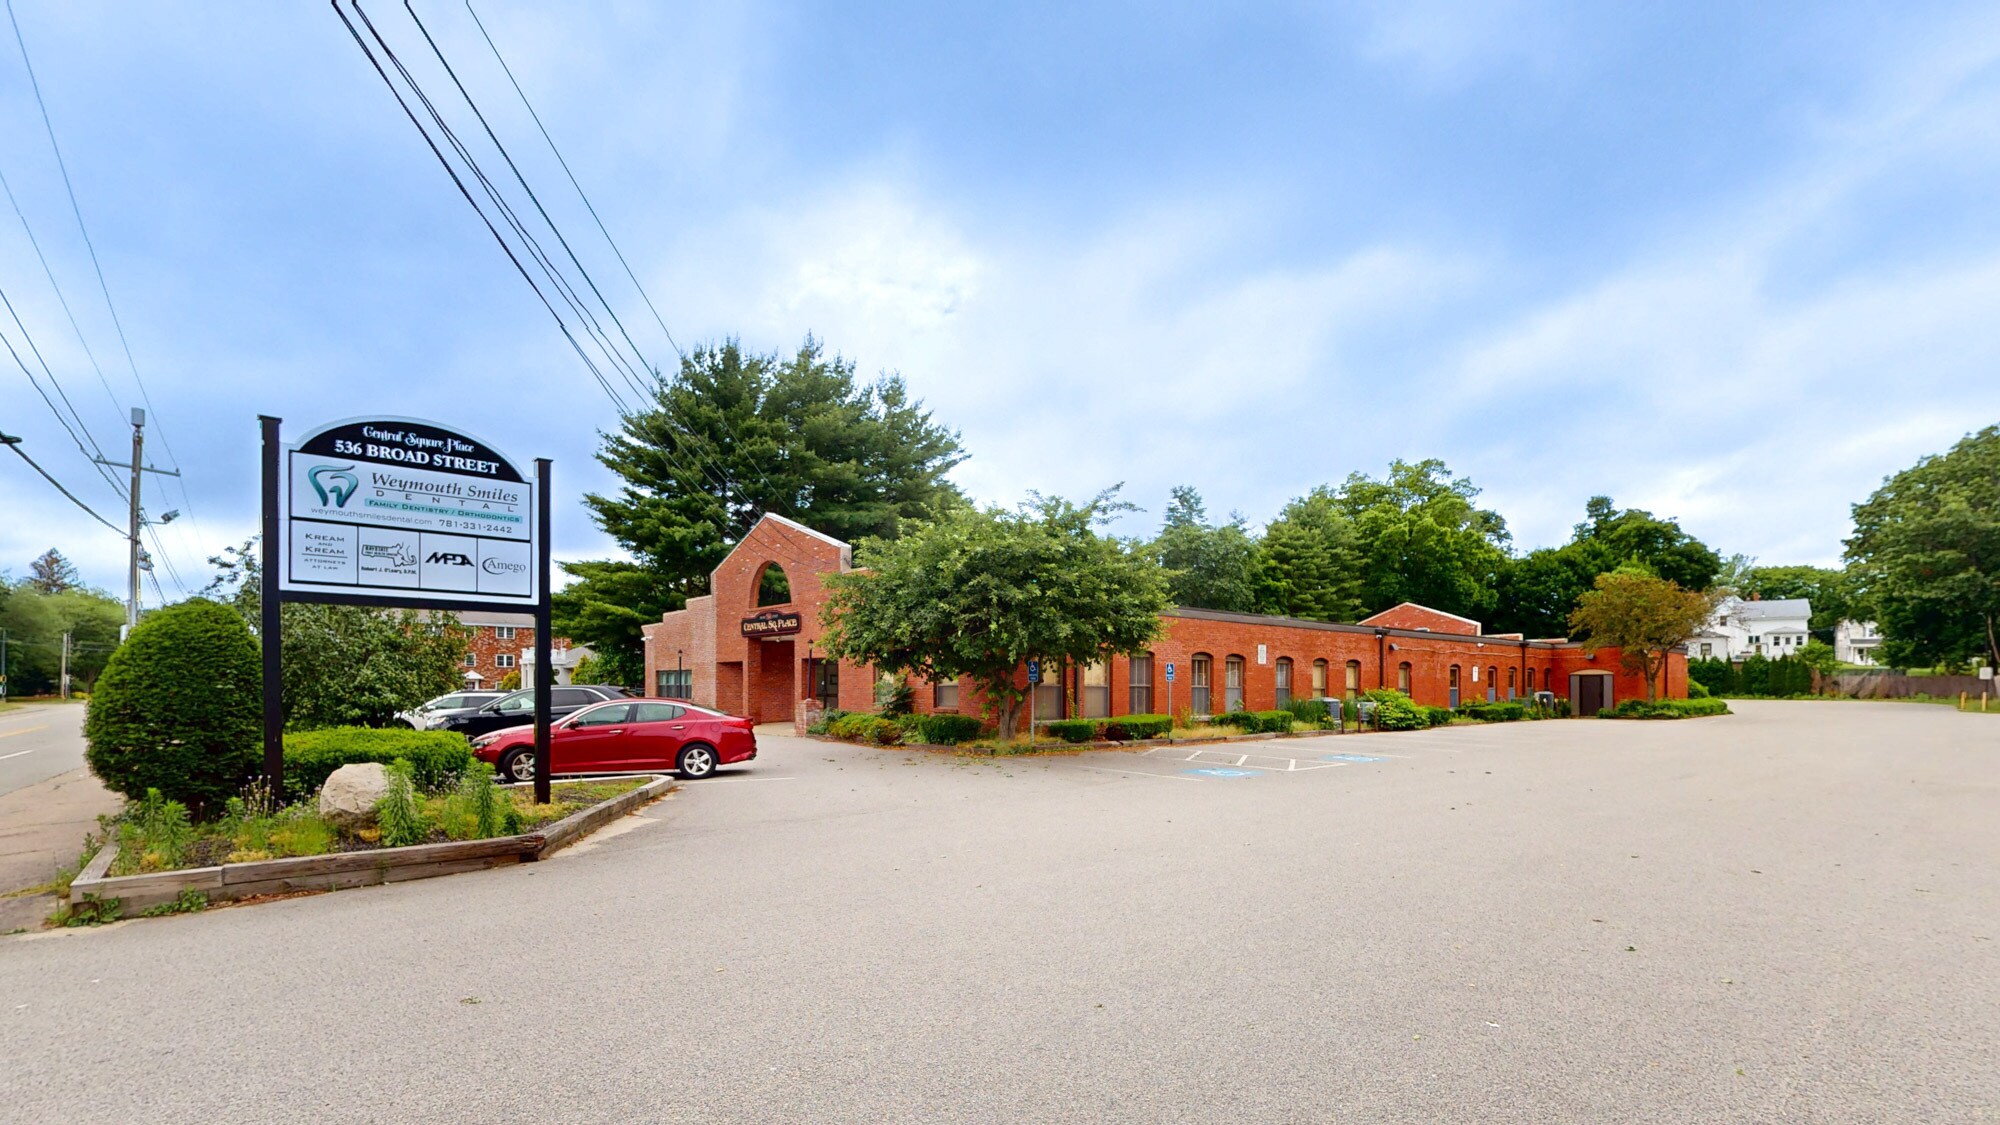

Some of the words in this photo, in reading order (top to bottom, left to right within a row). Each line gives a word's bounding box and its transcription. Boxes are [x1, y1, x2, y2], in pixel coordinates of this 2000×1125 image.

[362, 425, 404, 442] Central
[404, 432, 444, 449] Square
[443, 438, 474, 453] Place
[335, 439, 362, 455] 536
[366, 443, 430, 464] BROAD
[433, 454, 499, 474] STREET
[372, 472, 462, 496] Weymouth
[467, 485, 518, 502] Smiles
[376, 490, 514, 512] DENTAL
[311, 507, 432, 525] weymouthsmilesdental.com
[439, 519, 512, 533] 781-331-2442
[305, 533, 344, 542] KREAM
[305, 546, 344, 554] KREAM
[487, 559, 526, 573] Amego
[743, 621, 767, 631] CENTRAL
[778, 618, 797, 627] PLACE
